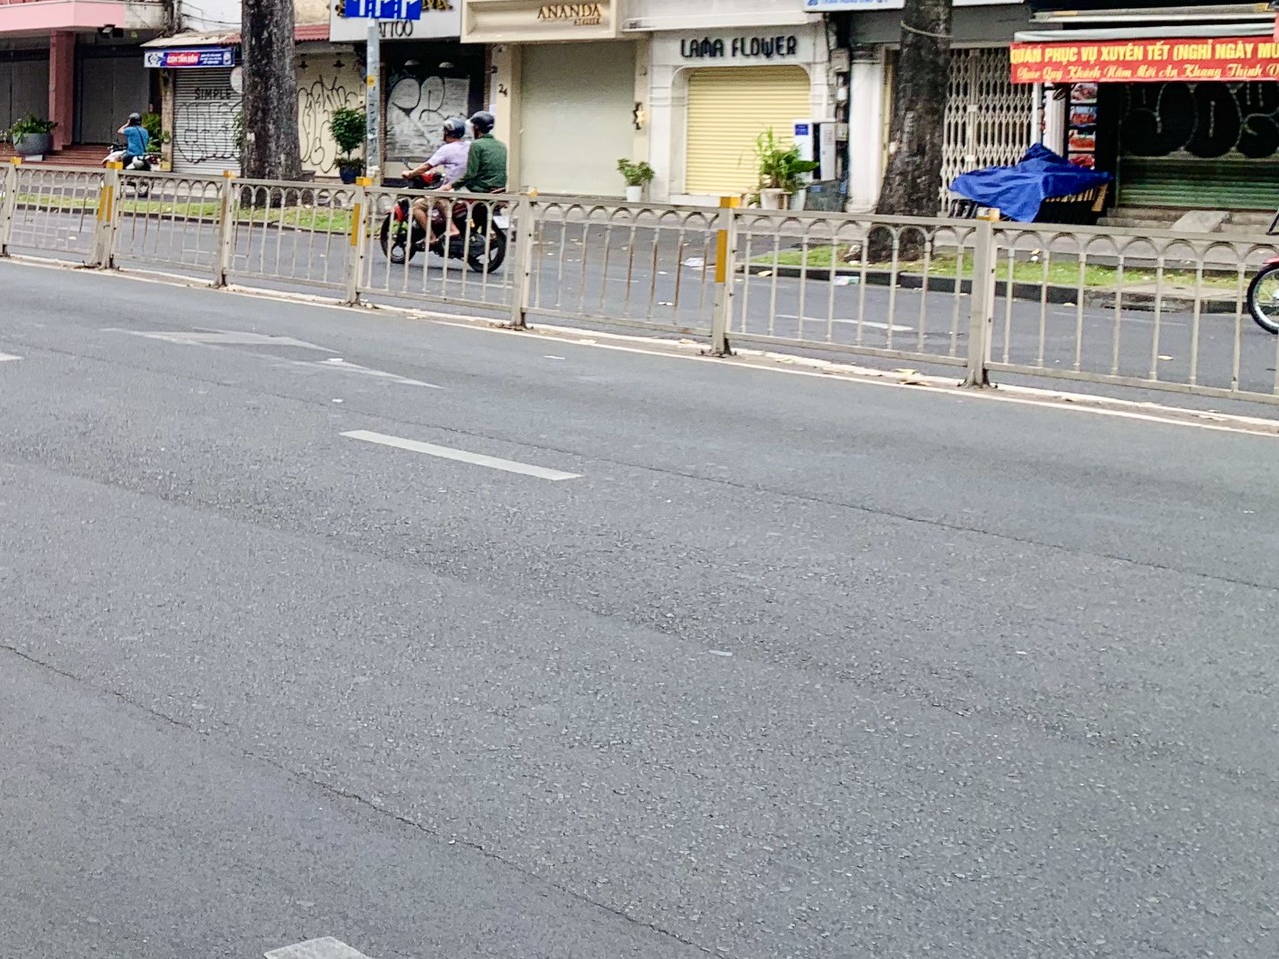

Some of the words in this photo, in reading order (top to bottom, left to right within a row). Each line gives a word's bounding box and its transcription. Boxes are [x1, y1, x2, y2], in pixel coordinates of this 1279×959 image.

[537, 3, 601, 19] ANANDA
[681, 37, 723, 58] LAMA
[732, 35, 797, 59] FLOWER
[1045, 46, 1078, 65] PHỤC
[1081, 46, 1098, 64] VỤ
[1100, 42, 1143, 61] XUYÊN
[1147, 40, 1170, 61] TẾT
[1215, 40, 1254, 59] NGÀY
[1182, 63, 1222, 80] Khang
[195, 88, 231, 100] SIMPLE
[498, 83, 508, 98] 24
